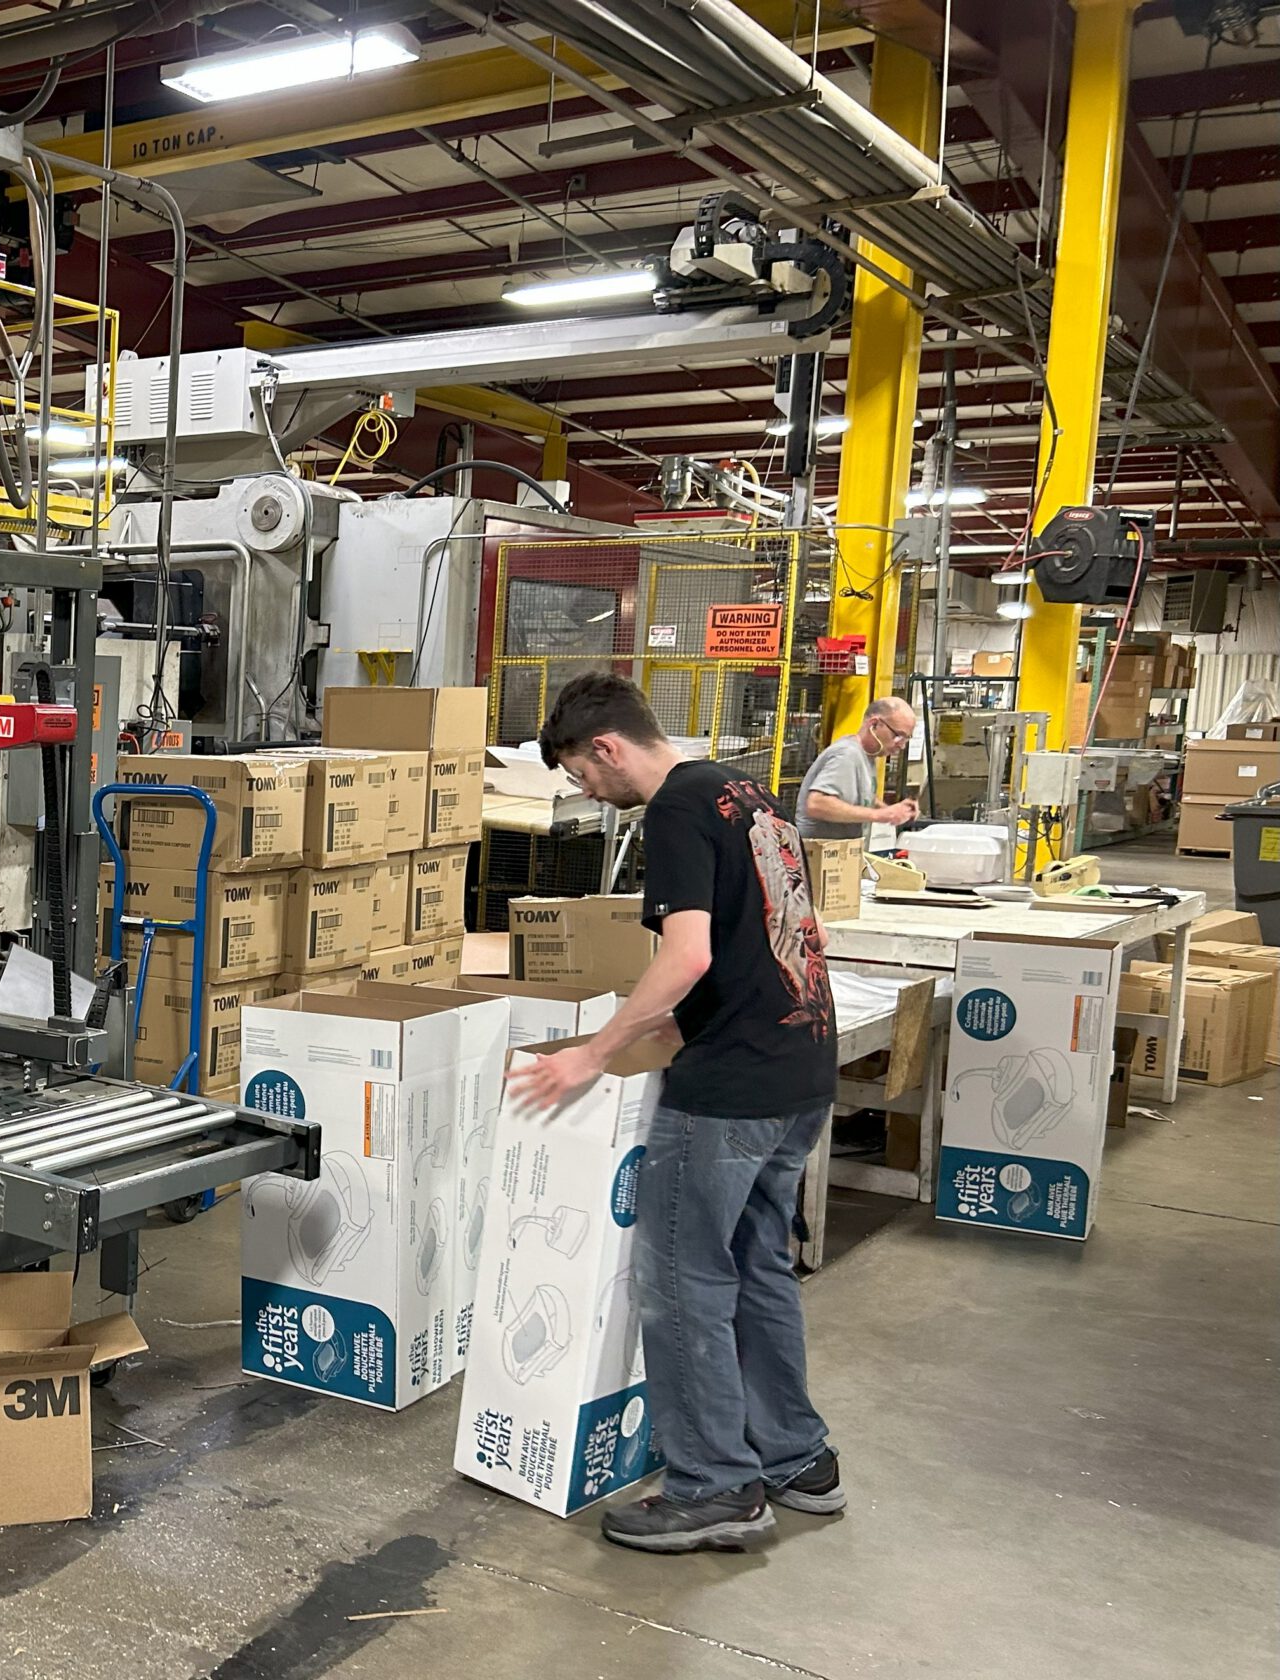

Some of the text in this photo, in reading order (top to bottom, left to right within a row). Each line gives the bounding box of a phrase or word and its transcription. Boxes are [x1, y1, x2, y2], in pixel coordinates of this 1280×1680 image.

[133, 126, 223, 160] 10 TON CAP.
[720, 613, 771, 624] WARNING
[123, 772, 168, 785] TOMY
[247, 777, 277, 792] TOMY
[329, 774, 356, 788] TOMY
[434, 763, 457, 776] TOMY
[418, 860, 441, 875] TOMY
[824, 850, 839, 859] TOMY
[104, 880, 150, 896] TMY
[224, 887, 252, 903] TOMY
[313, 880, 340, 896] TOMY
[514, 910, 561, 923] TOMY
[412, 955, 435, 971] TOMY
[213, 994, 241, 1012] TOMY
[1145, 1036, 1158, 1072] TOMY
[952, 1170, 965, 1188] the
[958, 1165, 981, 1203] first
[979, 1166, 998, 1215] years
[1048, 1184, 1056, 1198] AVEC
[1054, 1182, 1063, 1219] DOUCHETTE
[1060, 1176, 1072, 1228] PLUIE THERMALE
[1068, 1202, 1076, 1220] POUR
[255, 1310, 267, 1333] the
[262, 1302, 283, 1354] first
[284, 1308, 305, 1372] years
[368, 1323, 376, 1366] THERMALE
[411, 1334, 421, 1373] first
[420, 1330, 429, 1378] years
[360, 1332, 368, 1381] DOUCHETTE
[4, 1376, 81, 1421] 3M
[473, 1412, 485, 1433] the
[478, 1408, 499, 1453] first
[495, 1415, 513, 1472] years
[519, 1428, 532, 1477] BAIN AVEC
[527, 1428, 541, 1484] DOUCHETTE
[584, 1433, 594, 1461] the
[586, 1417, 609, 1477] first
[600, 1413, 620, 1485] years
[534, 1420, 551, 1500] PLUIE THERMALE
[544, 1464, 554, 1490] POUR
